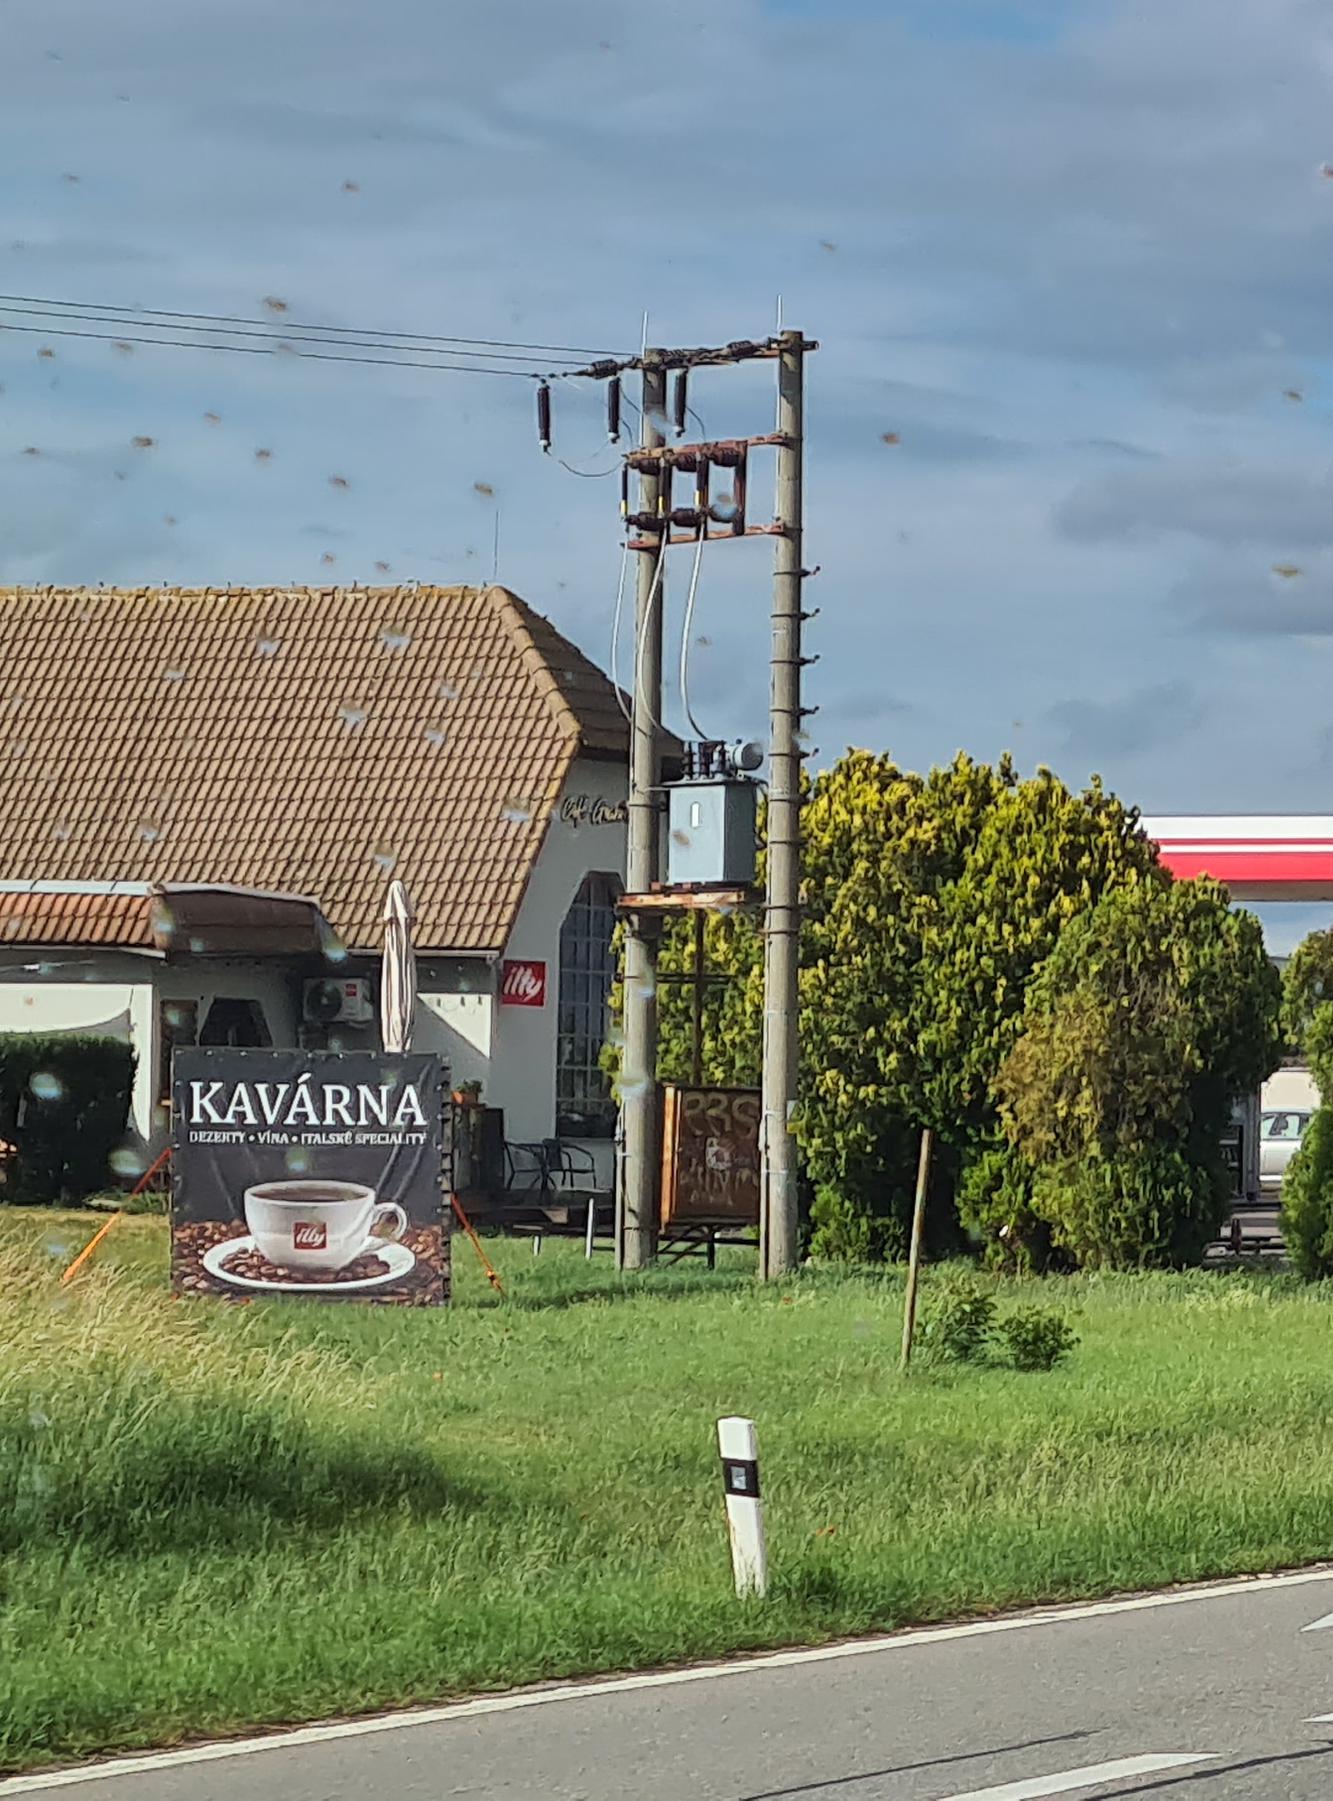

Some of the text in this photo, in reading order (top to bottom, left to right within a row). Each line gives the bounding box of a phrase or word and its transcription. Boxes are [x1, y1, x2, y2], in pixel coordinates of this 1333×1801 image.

[504, 967, 542, 1001] illy
[189, 1072, 428, 1127] KAVÁRNA
[189, 1129, 427, 1146] DEZERTY VÍNA ITALSKÉ SPECIALITY
[296, 1227, 325, 1247] illy
